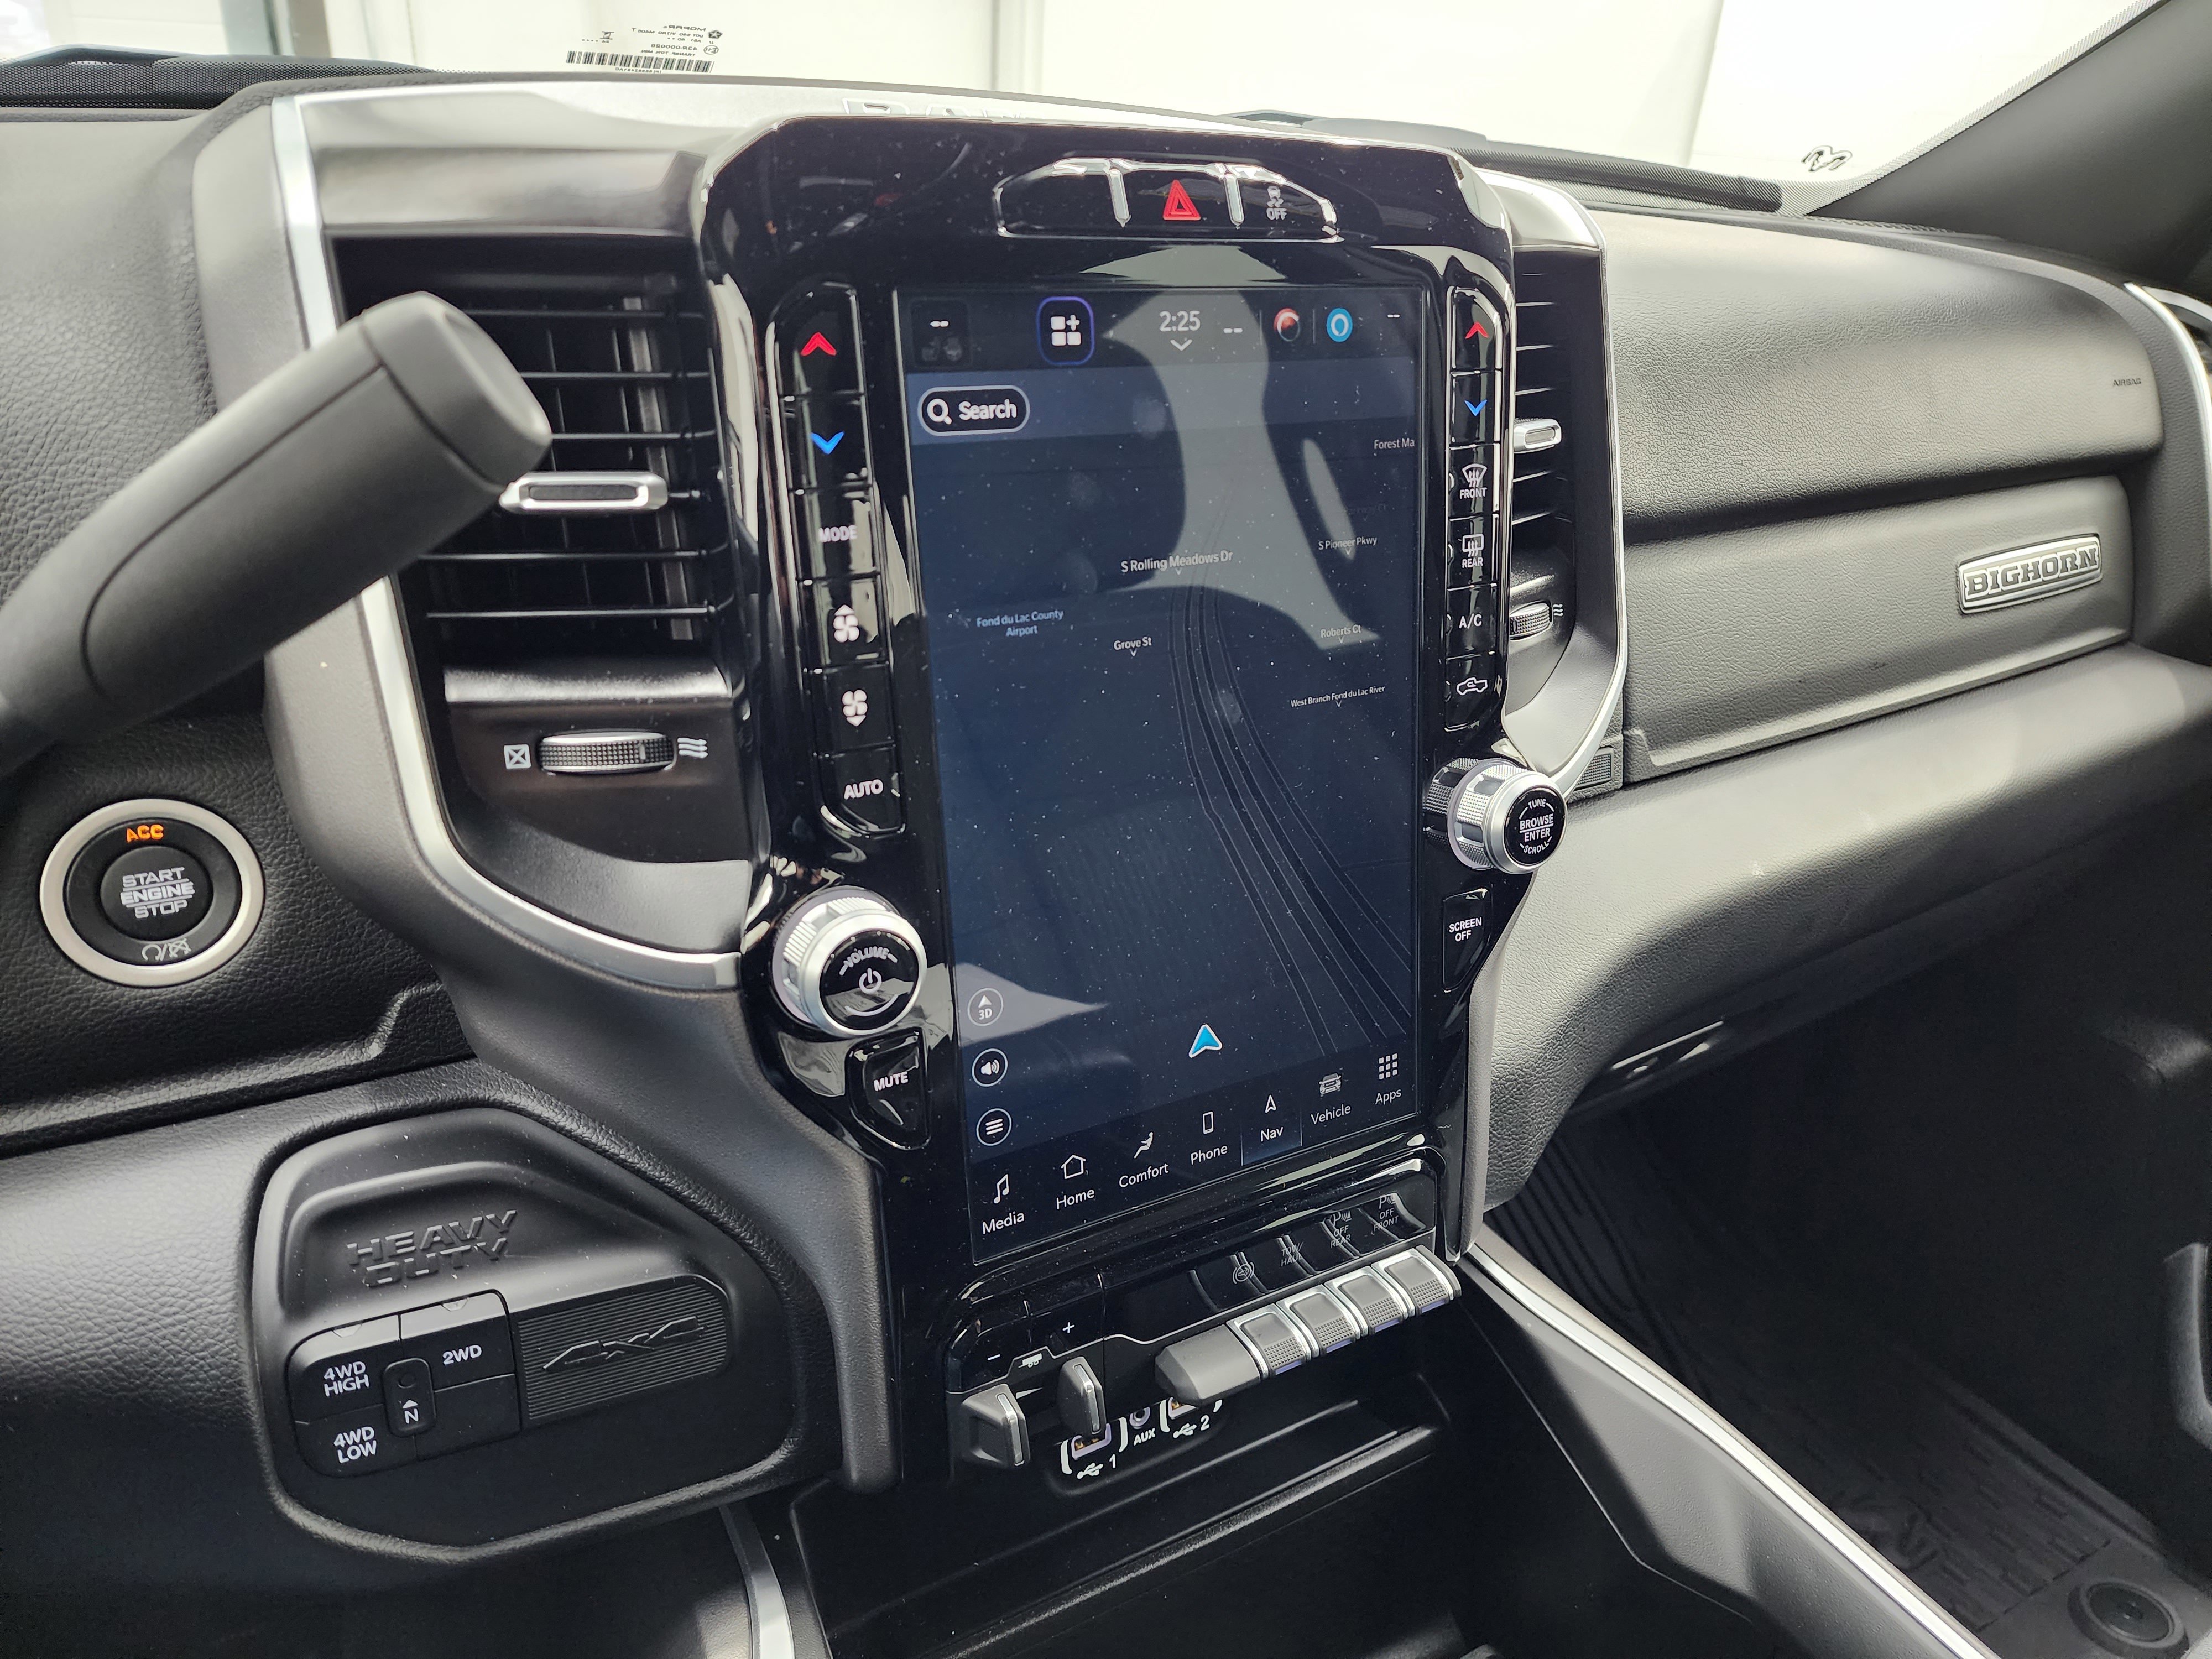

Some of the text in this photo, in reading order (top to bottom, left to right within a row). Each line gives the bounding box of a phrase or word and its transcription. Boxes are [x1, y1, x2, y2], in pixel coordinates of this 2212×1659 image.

[1266, 207, 1288, 221] OFF
[1160, 310, 1201, 332] 2:25
[2112, 378, 2142, 387] AIRBAG
[958, 399, 1017, 421] Search
[1374, 439, 1400, 450] Forest
[1459, 487, 1488, 499] FRONT
[818, 525, 858, 542] MODE
[1318, 536, 1378, 550] S Pioneer Pkwy
[1121, 550, 1234, 573] S Rolling Meadows Dr
[1462, 557, 1484, 568] REAR
[1964, 546, 2100, 602] BIGHORN
[977, 609, 1064, 628] Fond du Lac County
[1459, 613, 1483, 629] A/C
[1006, 625, 1038, 637] Airport
[1321, 624, 1361, 638] Roberts Ct
[1113, 636, 1152, 650] Grove St
[1291, 685, 1385, 708] West Branch Fond du Lac River
[844, 779, 884, 800] AUTO
[1527, 798, 1547, 810] TUNE
[1520, 813, 1554, 830] BROWSE
[126, 823, 164, 843] ACC
[1524, 827, 1551, 842] ENTER
[1523, 841, 1550, 854] SCROLL
[122, 867, 185, 888] START
[120, 880, 195, 905] ENGINE
[134, 899, 188, 919] STOP
[1449, 917, 1482, 933] SCREEN
[1455, 930, 1472, 942] OFF
[844, 946, 890, 968] VOLUME
[978, 1008, 993, 1020] 3D
[874, 1071, 909, 1092] MUTE
[1375, 1088, 1402, 1105] Apps
[1311, 1104, 1351, 1125] Vehicle
[1260, 1126, 1284, 1142] Nav
[1190, 1144, 1228, 1165] Phone
[1119, 1162, 1169, 1188] Comfort
[1056, 1188, 1095, 1209] Home
[1379, 1207, 1395, 1220] OFF
[982, 1211, 1025, 1235] Media
[1333, 1224, 1350, 1237] OFF
[1374, 1215, 1399, 1232] FRONT
[347, 1209, 517, 1266] HEAVY
[1331, 1234, 1351, 1248] REAR
[362, 1237, 507, 1288] DUTY
[1280, 1254, 1303, 1267] HAUL
[442, 1345, 482, 1365] 2WD
[324, 1361, 366, 1381] 4WD
[324, 1374, 369, 1397] HIGH
[404, 1408, 419, 1424] N
[1200, 1415, 1210, 1431] 2
[333, 1426, 375, 1448] 4WD
[1134, 1427, 1156, 1446] AUX
[337, 1440, 377, 1464] LOW
[1109, 1453, 1116, 1469] 1
